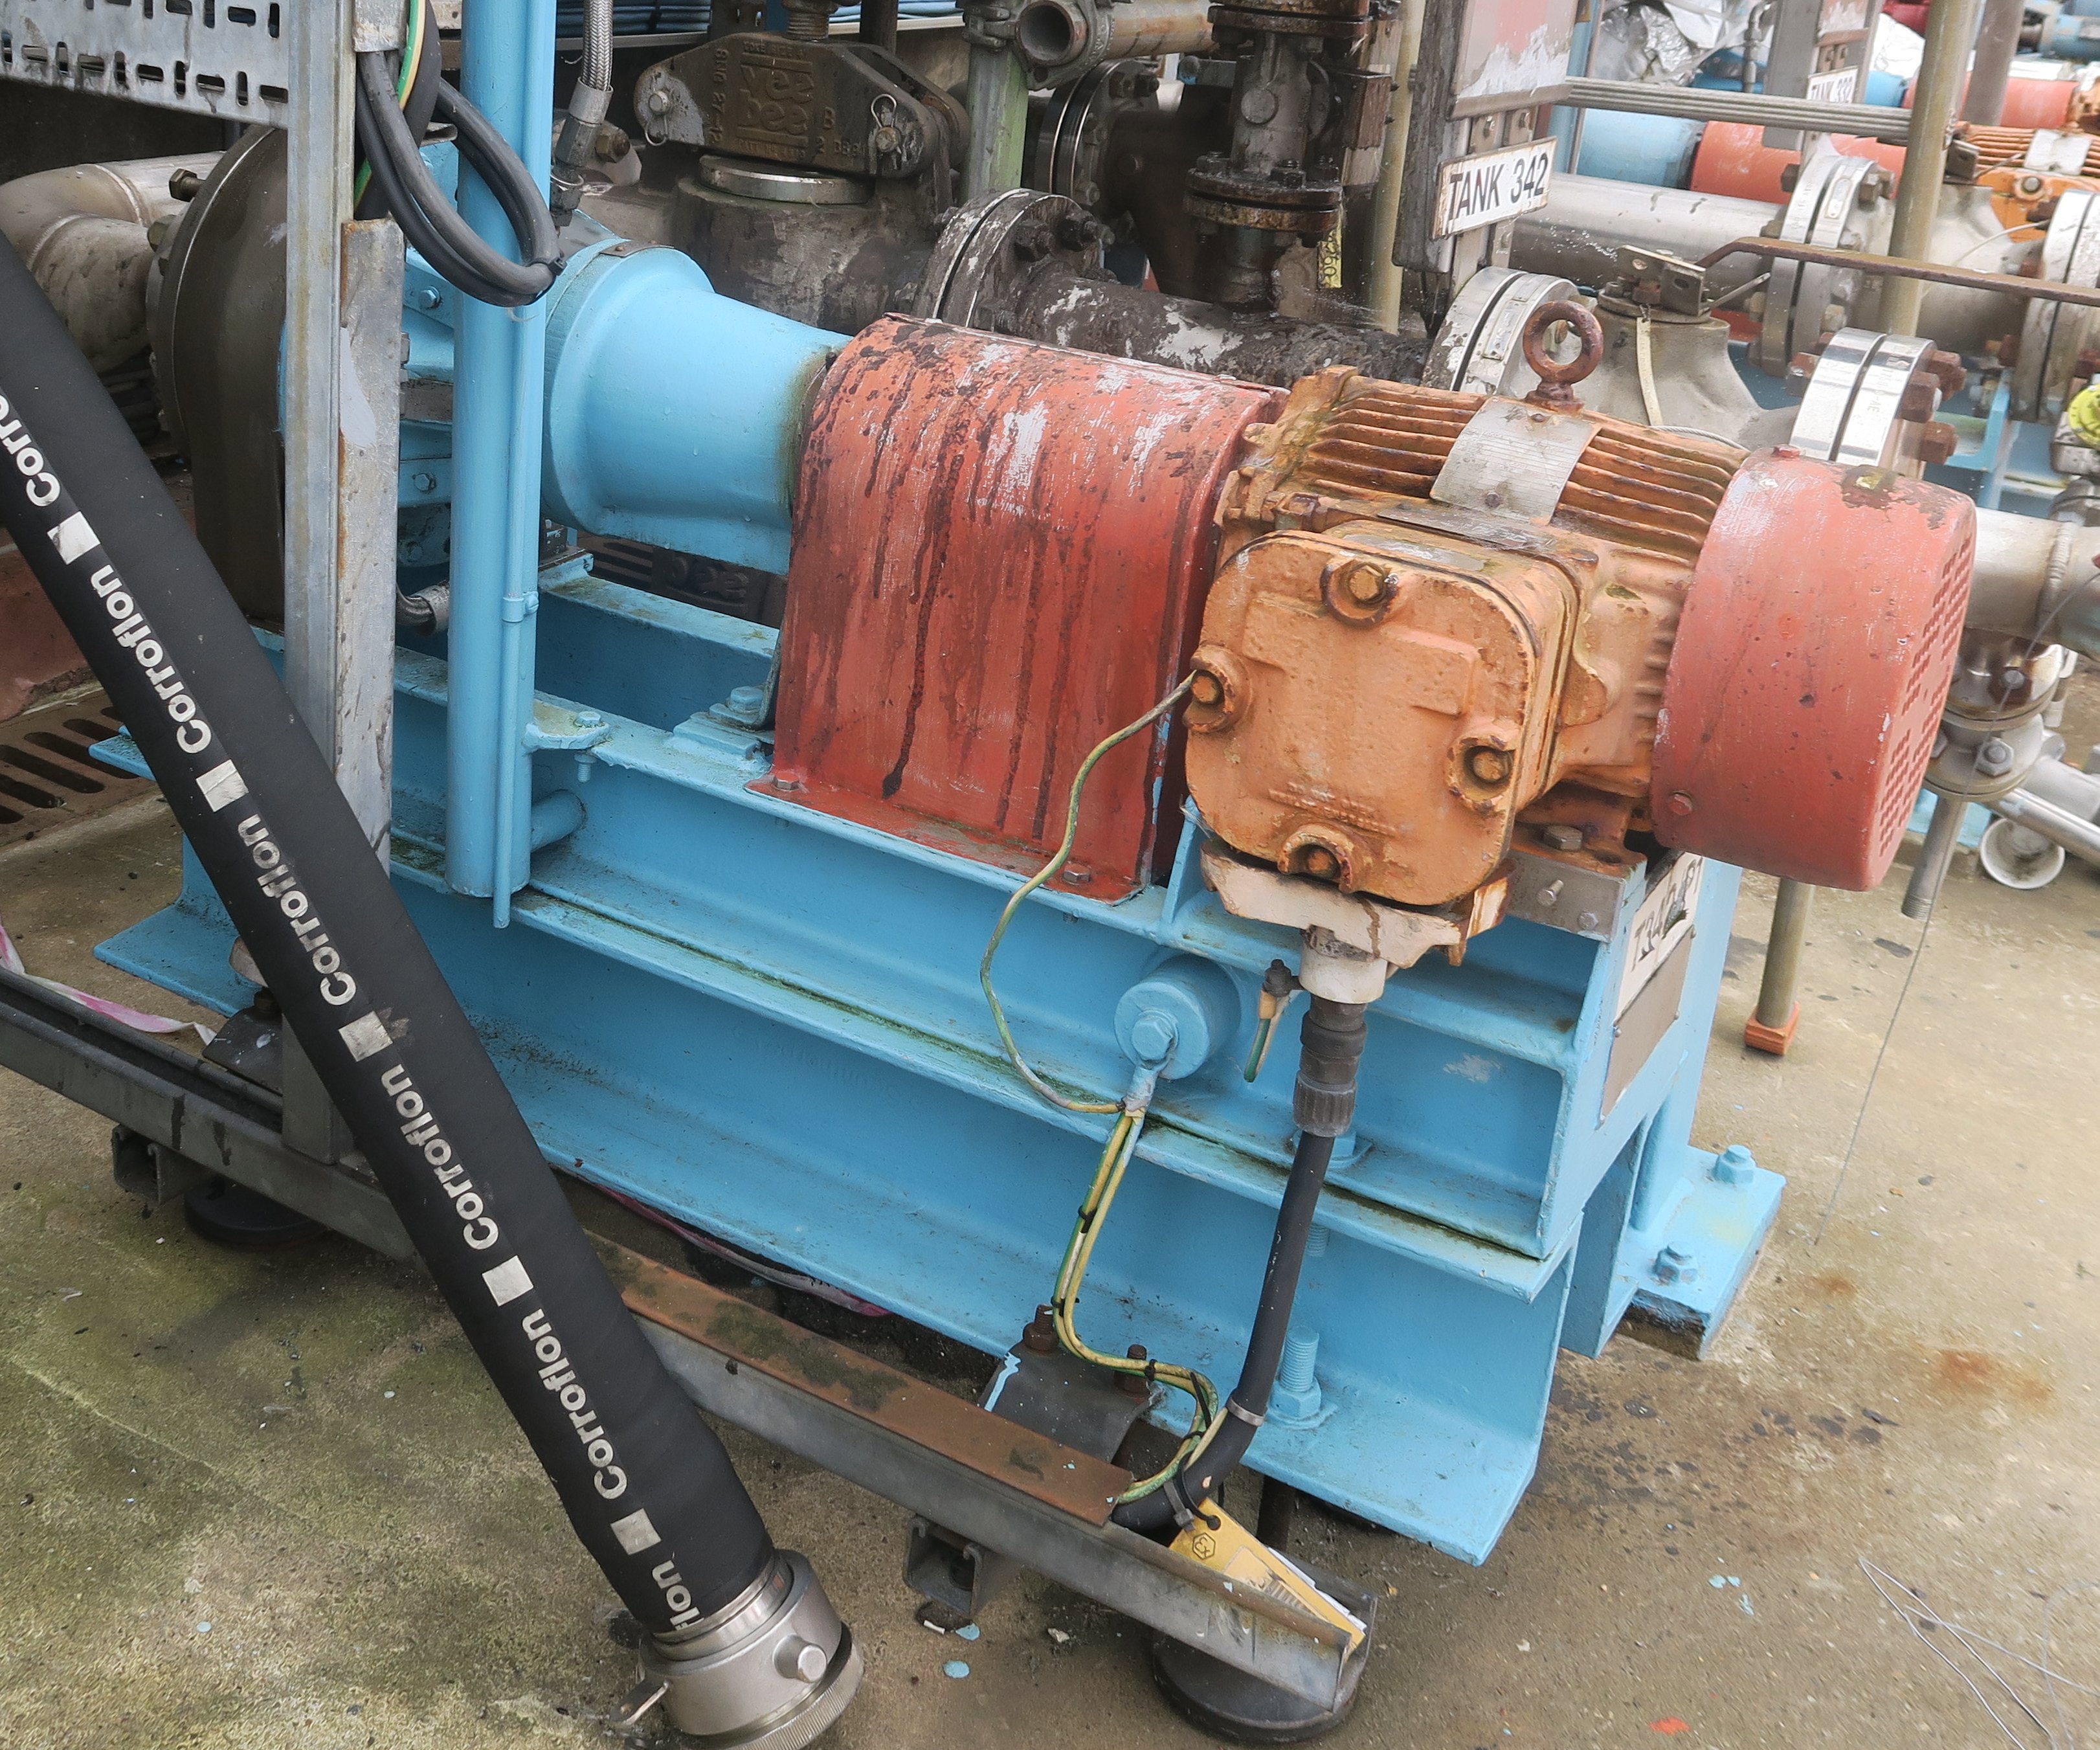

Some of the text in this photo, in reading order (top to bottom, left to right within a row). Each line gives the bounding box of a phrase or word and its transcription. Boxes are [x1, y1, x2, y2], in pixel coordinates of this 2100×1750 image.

[1448, 152, 1548, 221] TANK 342
[90, 564, 212, 754] Corroflon
[238, 813, 357, 1005] Corroflon
[381, 1063, 499, 1250] Corroflon
[522, 1308, 627, 1499] Corroflon
